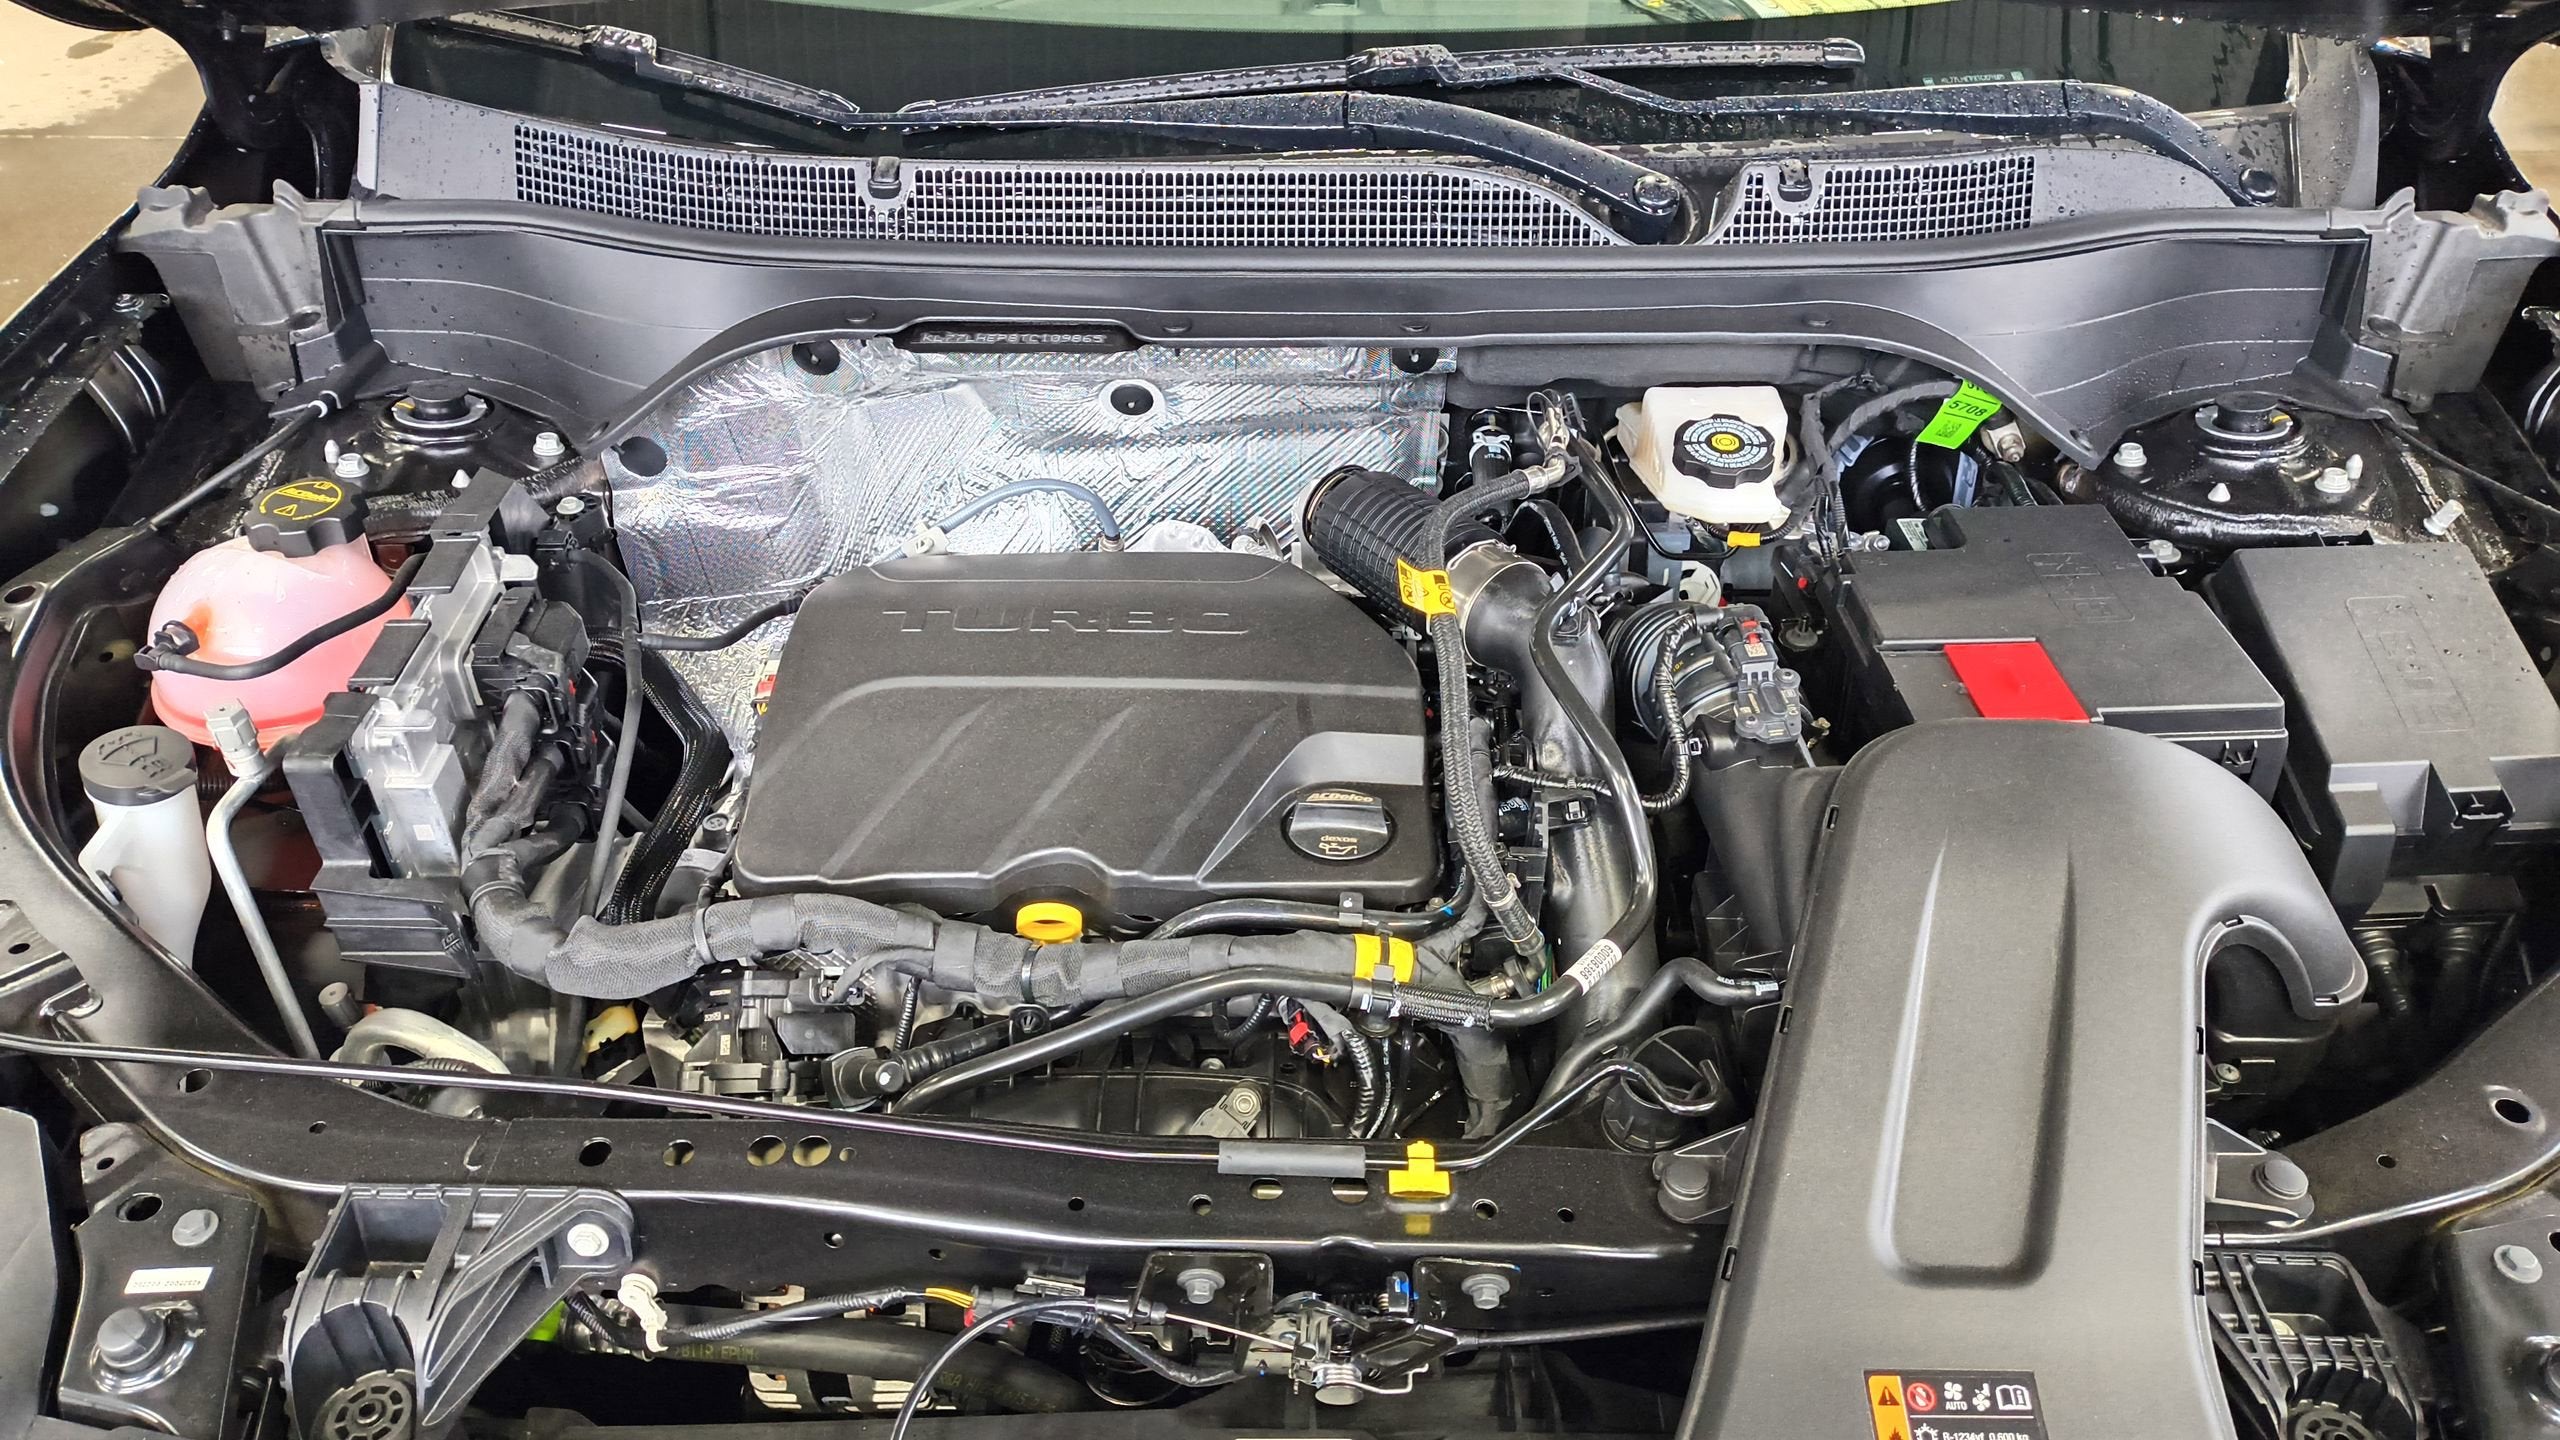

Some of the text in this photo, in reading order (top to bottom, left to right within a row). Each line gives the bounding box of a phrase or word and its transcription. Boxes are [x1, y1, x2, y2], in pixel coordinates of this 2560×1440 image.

[1949, 400, 1988, 416] 5708
[882, 609, 1250, 634] TURBO
[1306, 792, 1374, 803] ACDelco
[1320, 834, 1358, 843] dexos
[1945, 1401, 1968, 1411] AUTO
